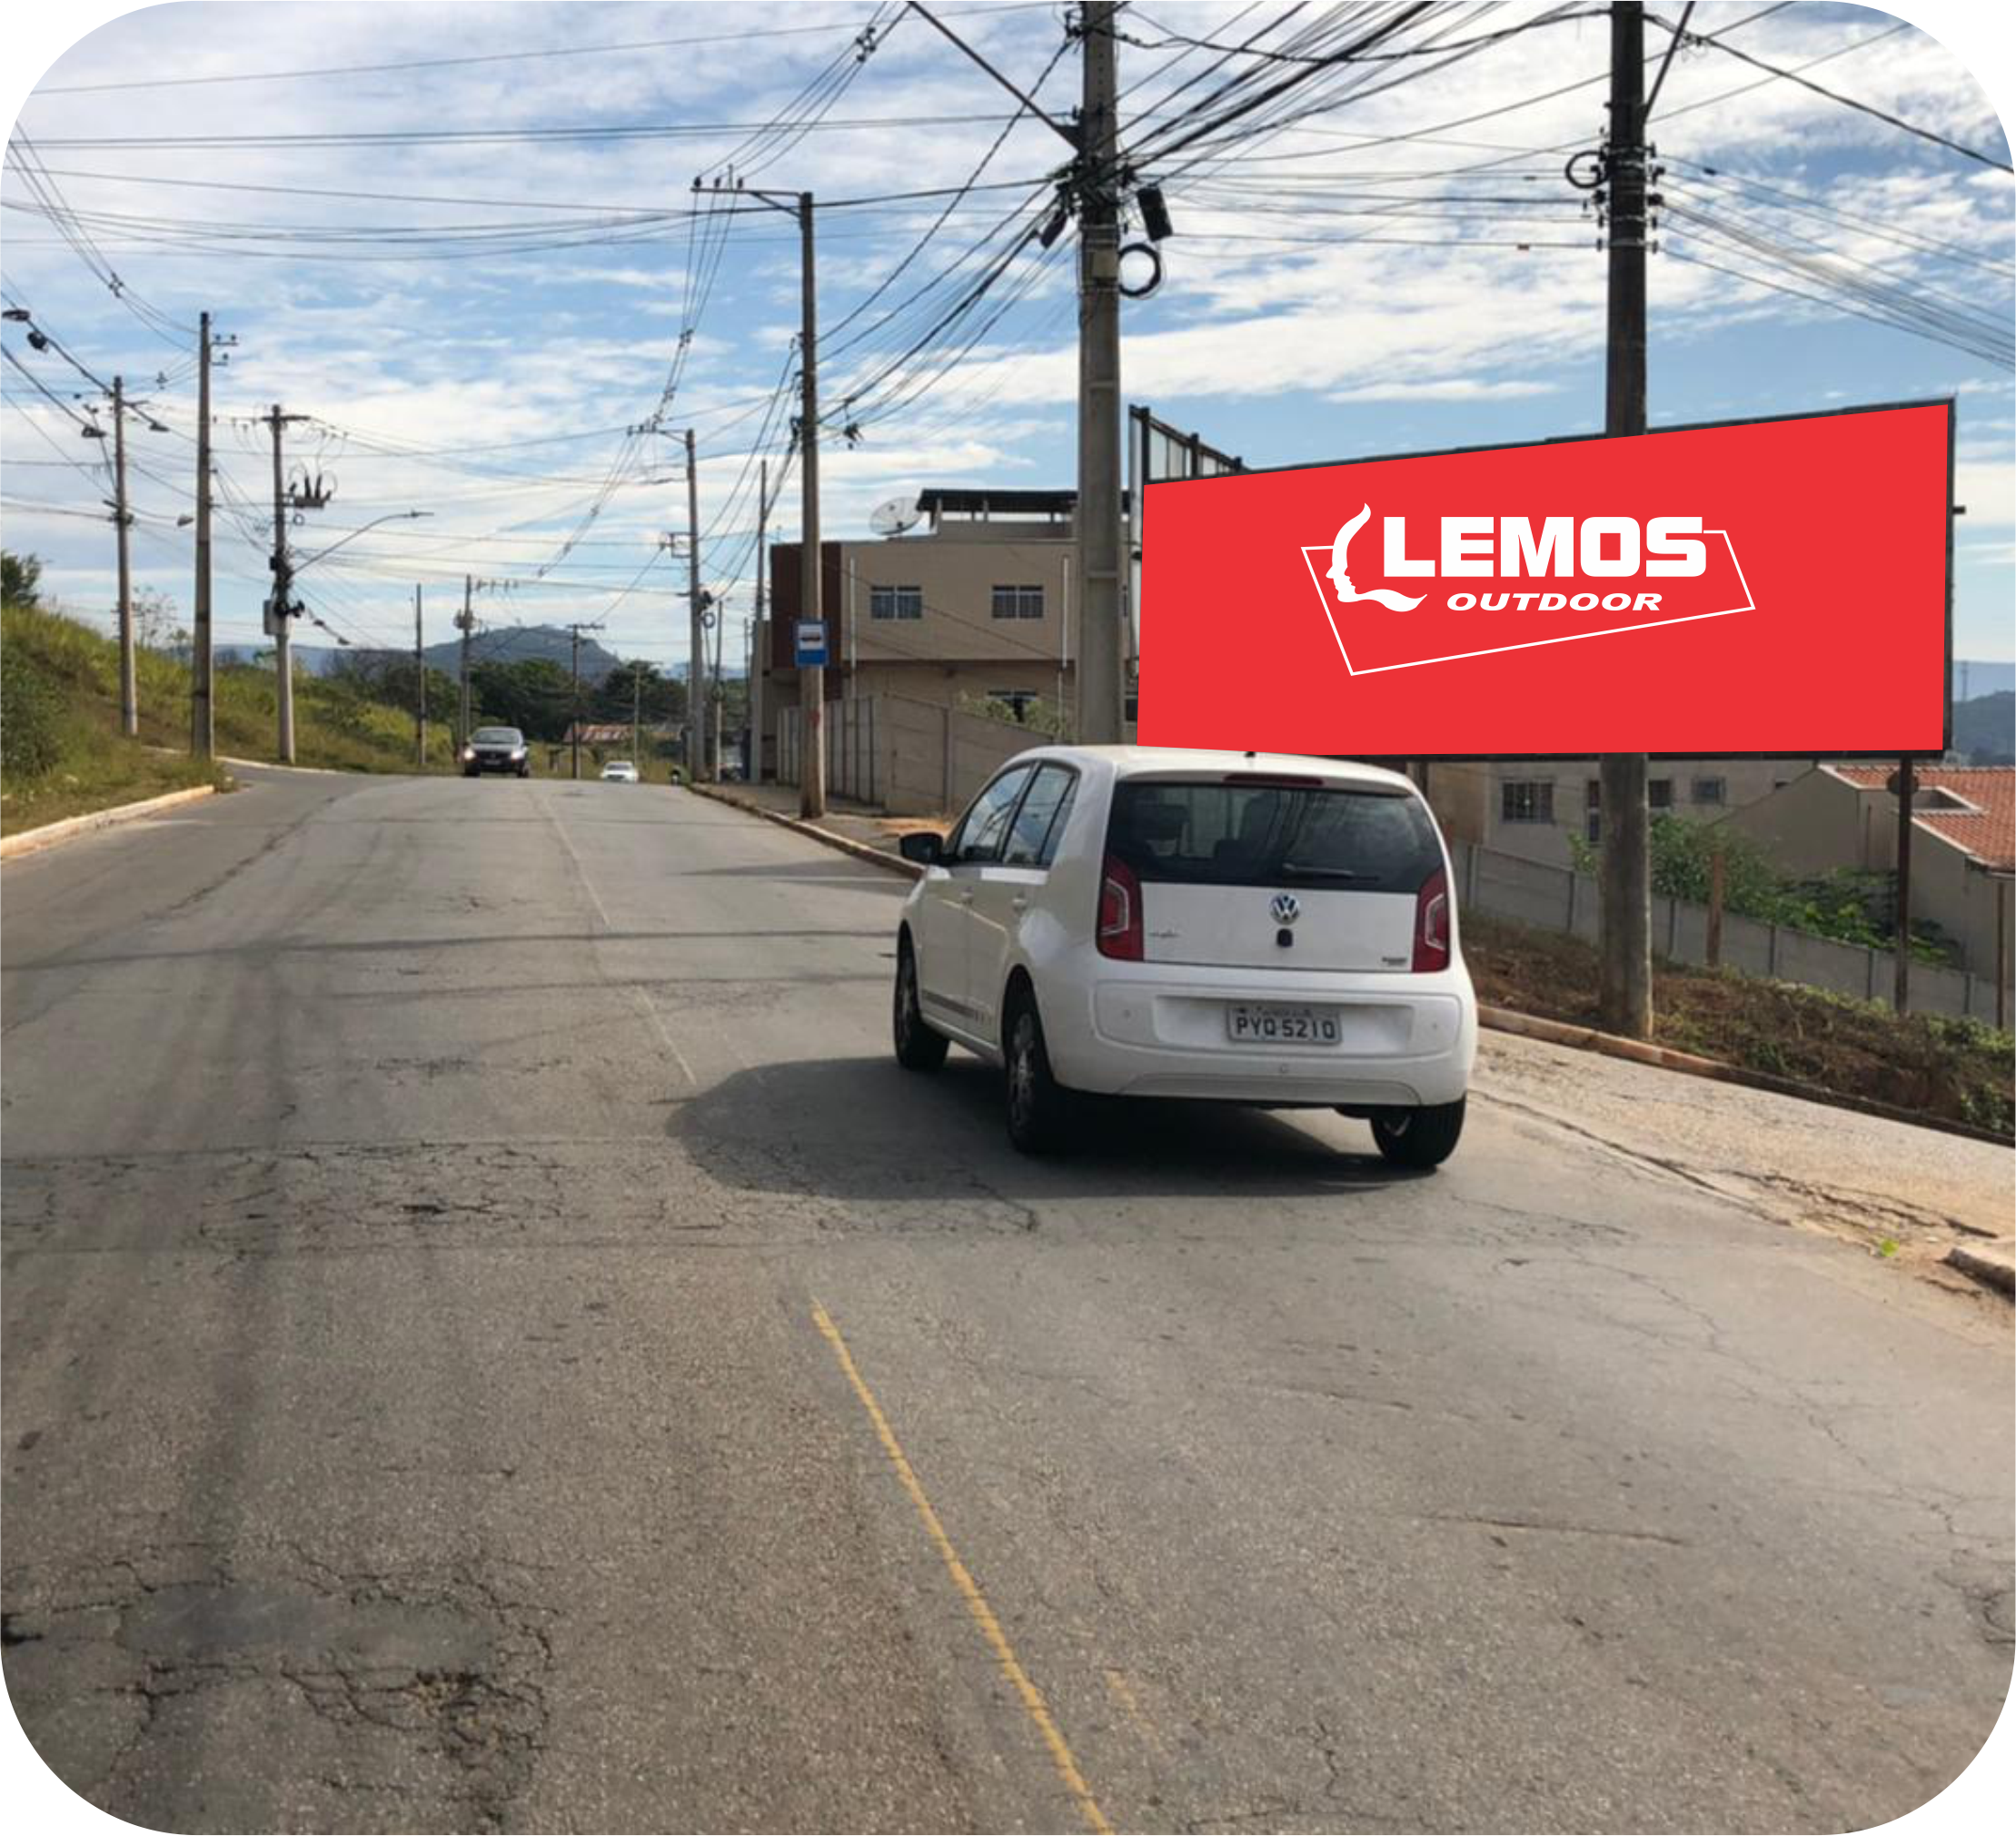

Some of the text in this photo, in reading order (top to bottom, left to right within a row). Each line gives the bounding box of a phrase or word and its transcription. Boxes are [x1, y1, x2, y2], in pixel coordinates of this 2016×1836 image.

[1384, 516, 1707, 577] LEMOS
[1446, 592, 1663, 611] OUTDOOR
[1282, 1018, 1336, 1039] 5210
